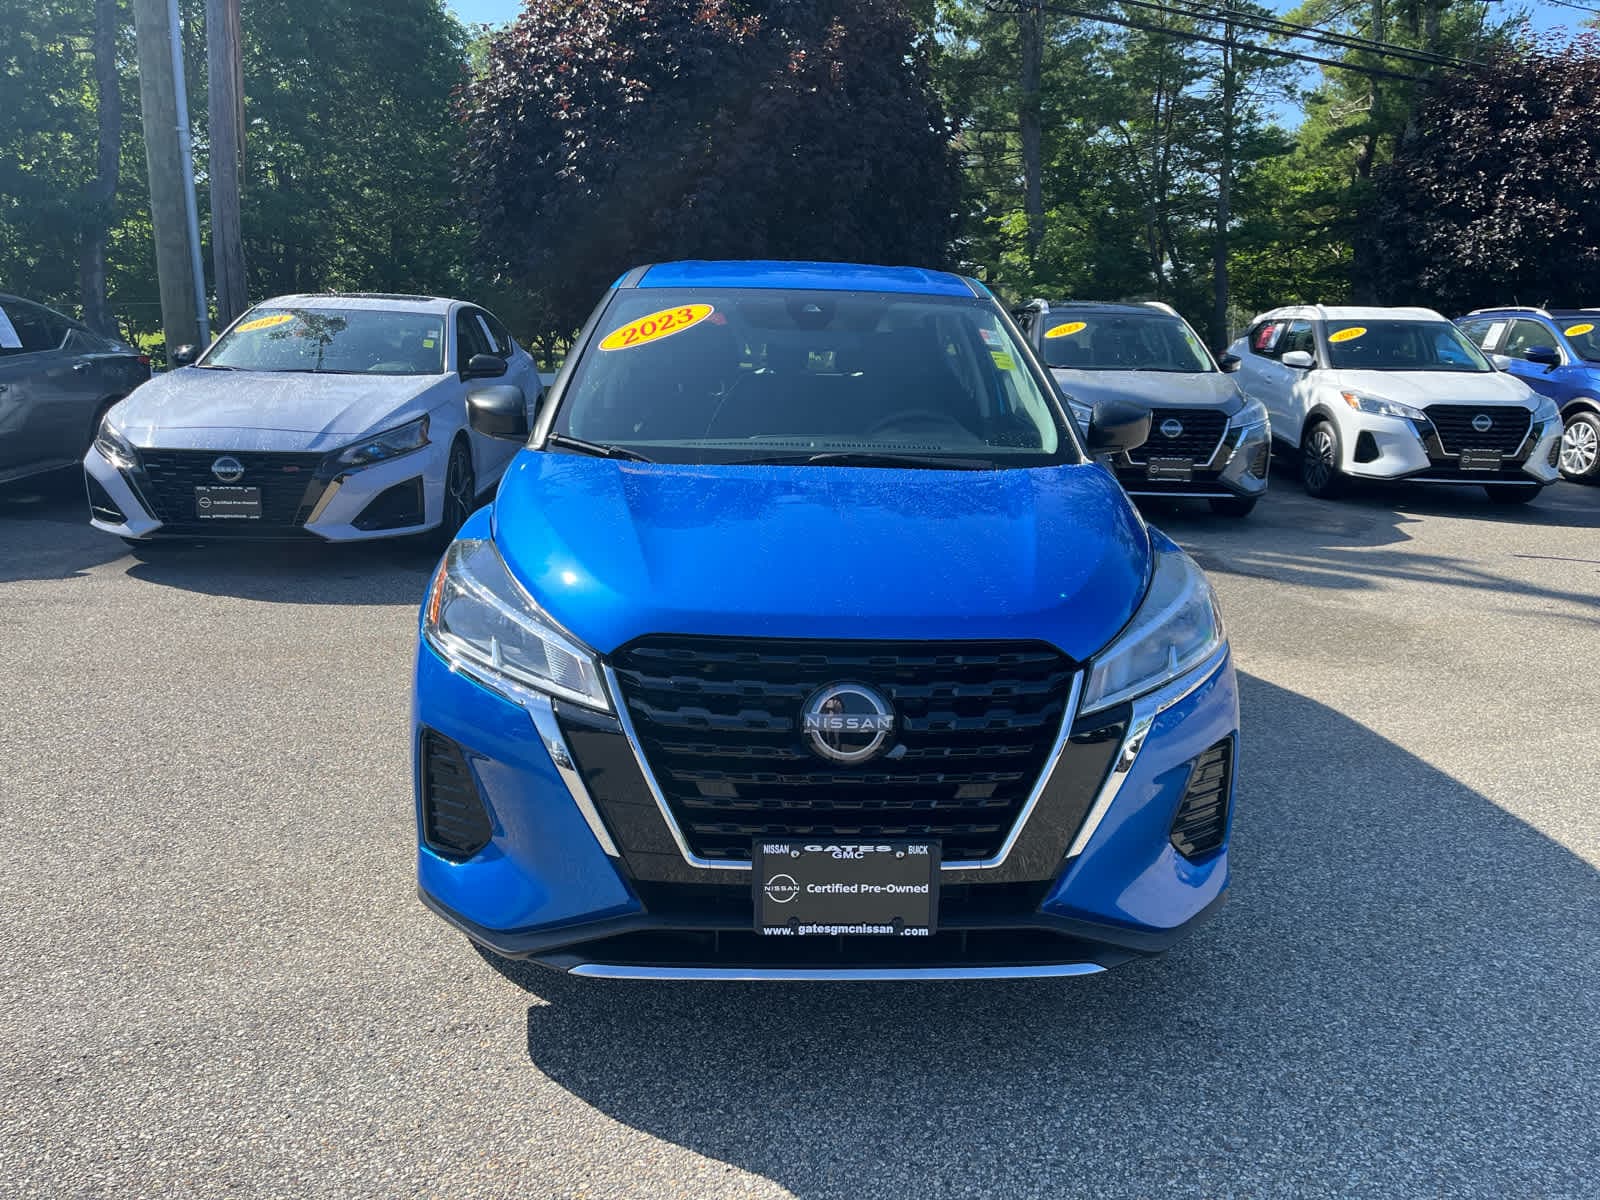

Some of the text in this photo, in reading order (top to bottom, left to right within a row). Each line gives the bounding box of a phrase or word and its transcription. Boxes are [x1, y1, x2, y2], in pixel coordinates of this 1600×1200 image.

[622, 308, 694, 345] 2023
[806, 717, 890, 729] NISSAN
[763, 845, 790, 855] NISSAN
[908, 846, 929, 855] BUICK
[831, 851, 865, 859] GMC
[807, 883, 929, 893] Certified Pre-Owned
[763, 923, 929, 936] www. gatesgmcnissan .com
